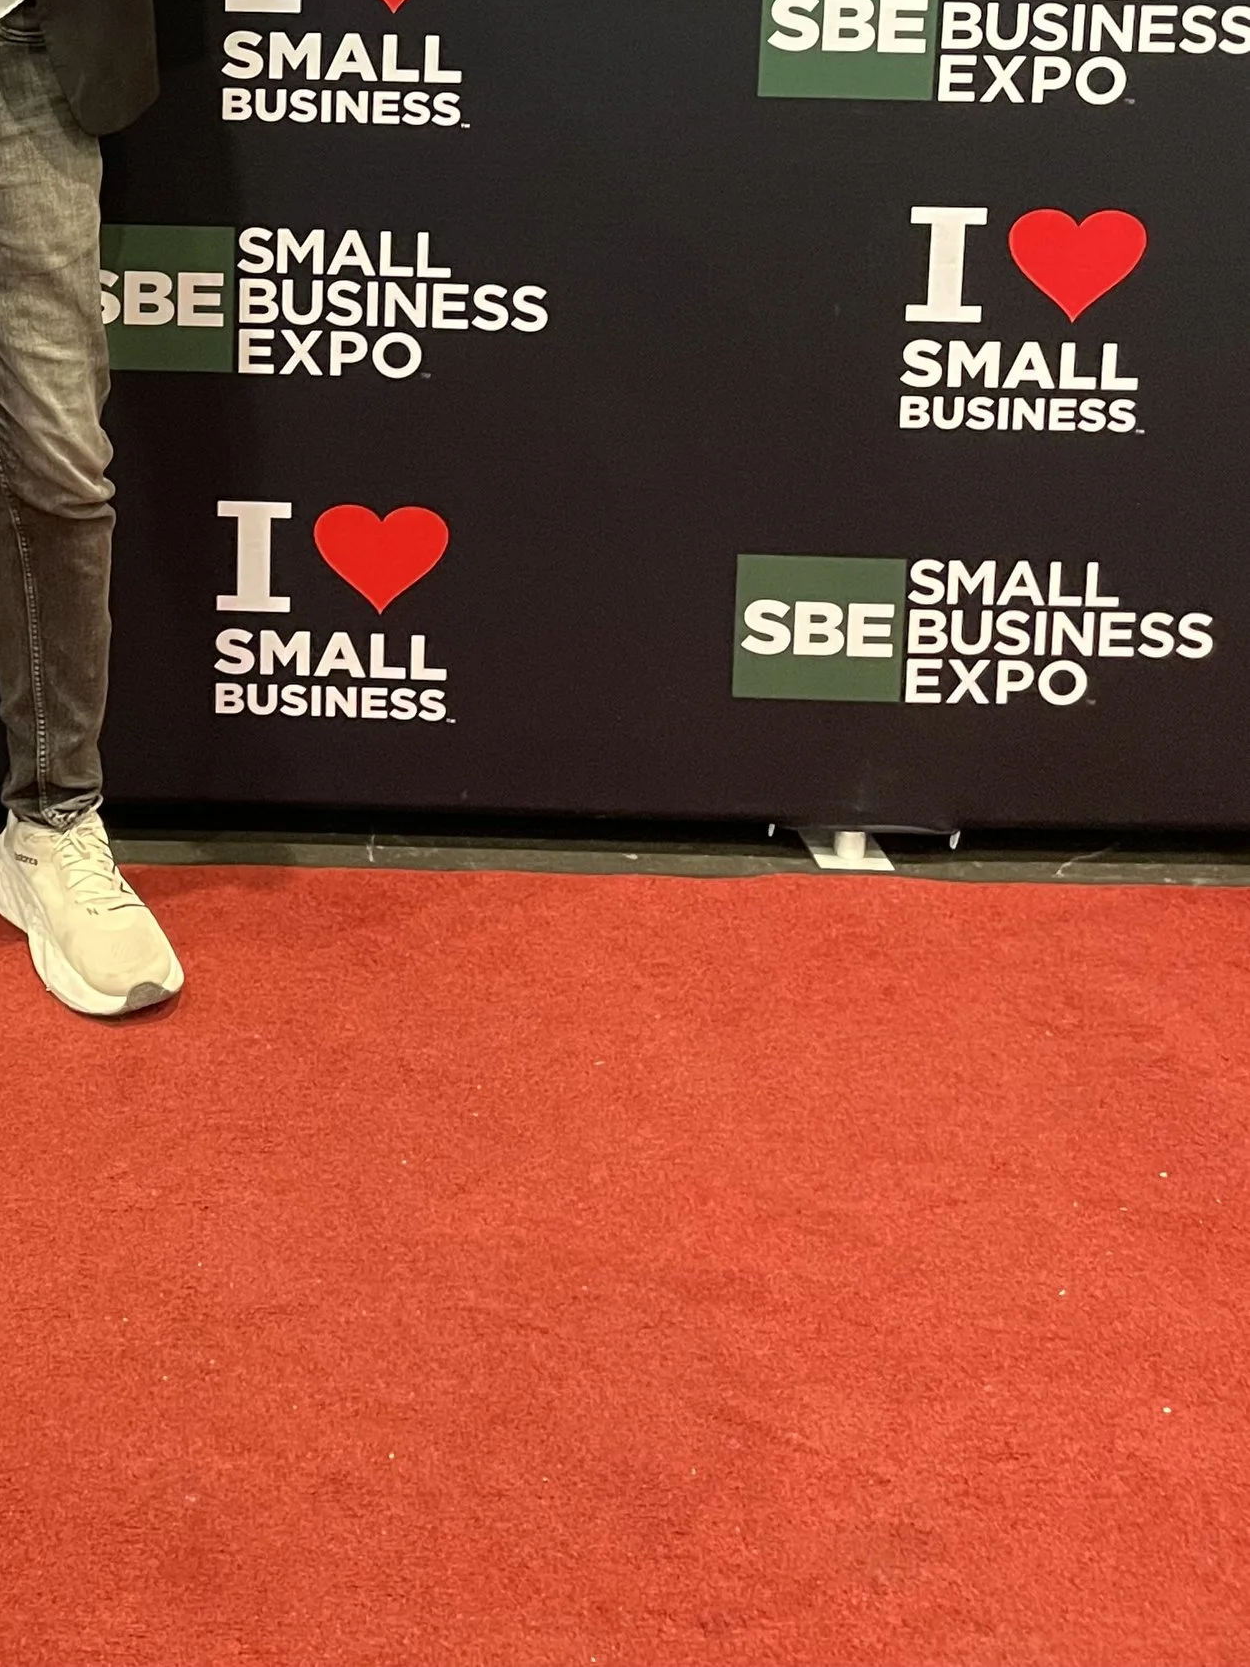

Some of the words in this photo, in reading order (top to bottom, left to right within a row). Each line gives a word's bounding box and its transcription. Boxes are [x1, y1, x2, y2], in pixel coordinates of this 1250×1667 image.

[941, 2, 1250, 54] BUSINESS
[222, 31, 462, 83] SMALL
[938, 55, 1126, 105] EXPO
[222, 88, 460, 126] BUSINESS
[237, 227, 451, 278] SMALL
[905, 207, 987, 322] I
[239, 278, 548, 332] BUSINESS
[239, 329, 421, 378] EXPO
[900, 339, 1138, 390] SMALL
[900, 396, 1136, 432] BUSINESS
[217, 501, 291, 612] I
[908, 559, 1119, 607] SMALL
[741, 600, 895, 657] SBE
[908, 609, 1213, 658] BUSINESS
[214, 629, 447, 680] SMALL
[216, 683, 446, 721] BUSINESS
[905, 659, 1087, 705] EXPO
